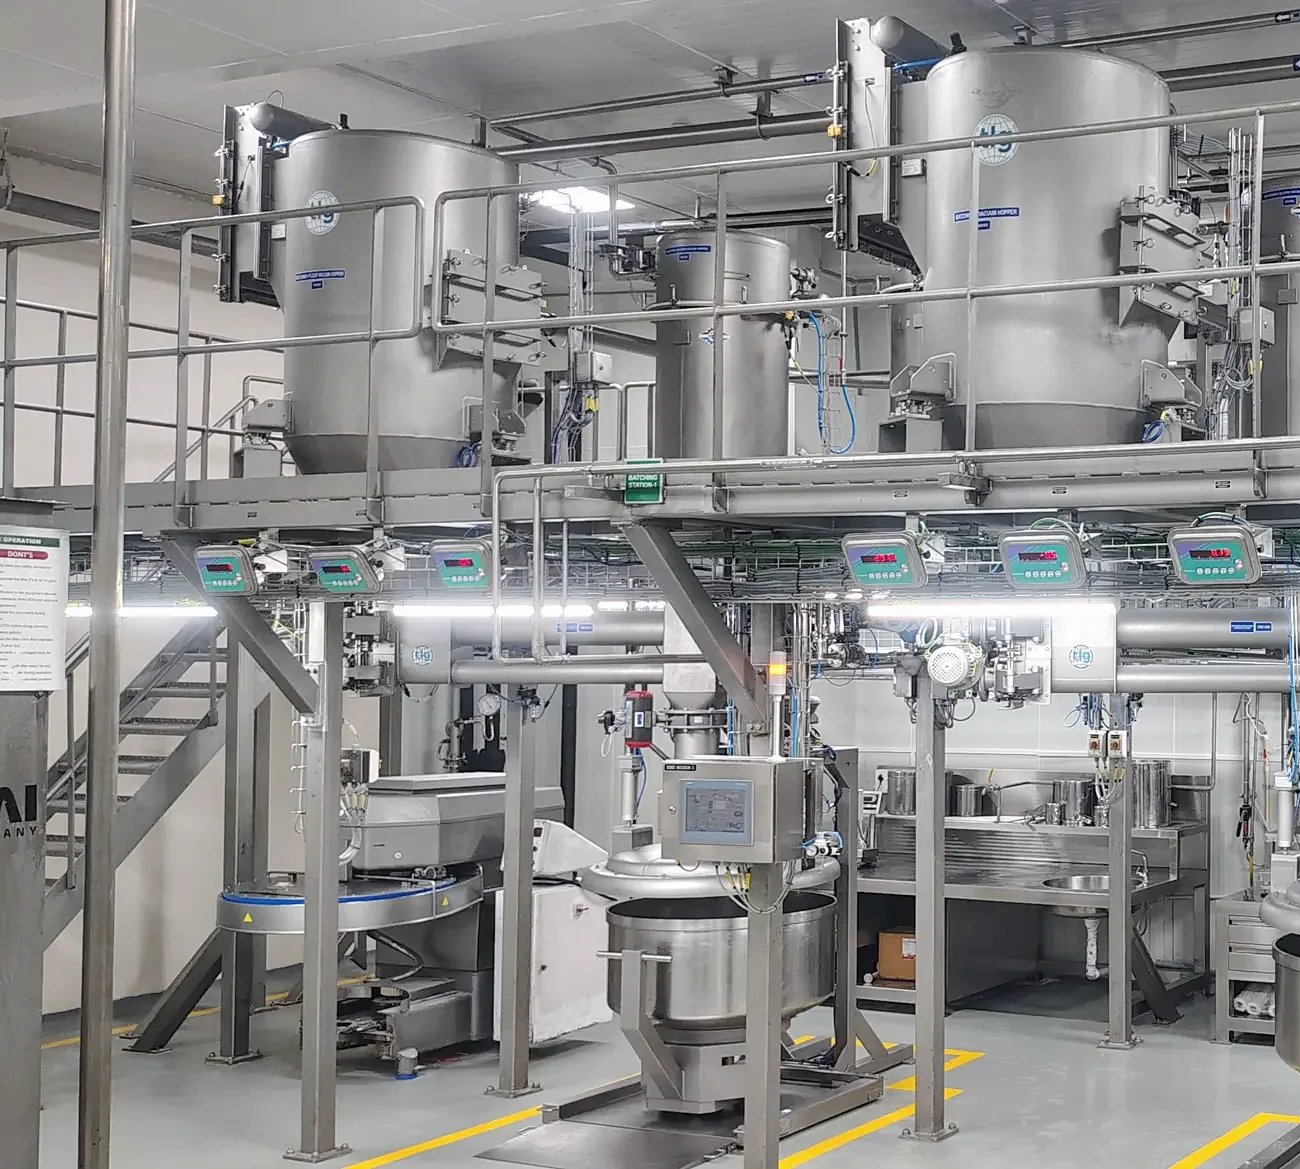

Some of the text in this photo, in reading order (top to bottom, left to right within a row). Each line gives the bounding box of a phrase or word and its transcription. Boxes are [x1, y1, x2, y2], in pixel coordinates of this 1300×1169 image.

[628, 481, 657, 489] STATION-1
[3, 536, 42, 545] OPERATION
[7, 550, 34, 559] DONT'S
[1072, 651, 1090, 663] tlg
[4, 826, 37, 839] ANY
